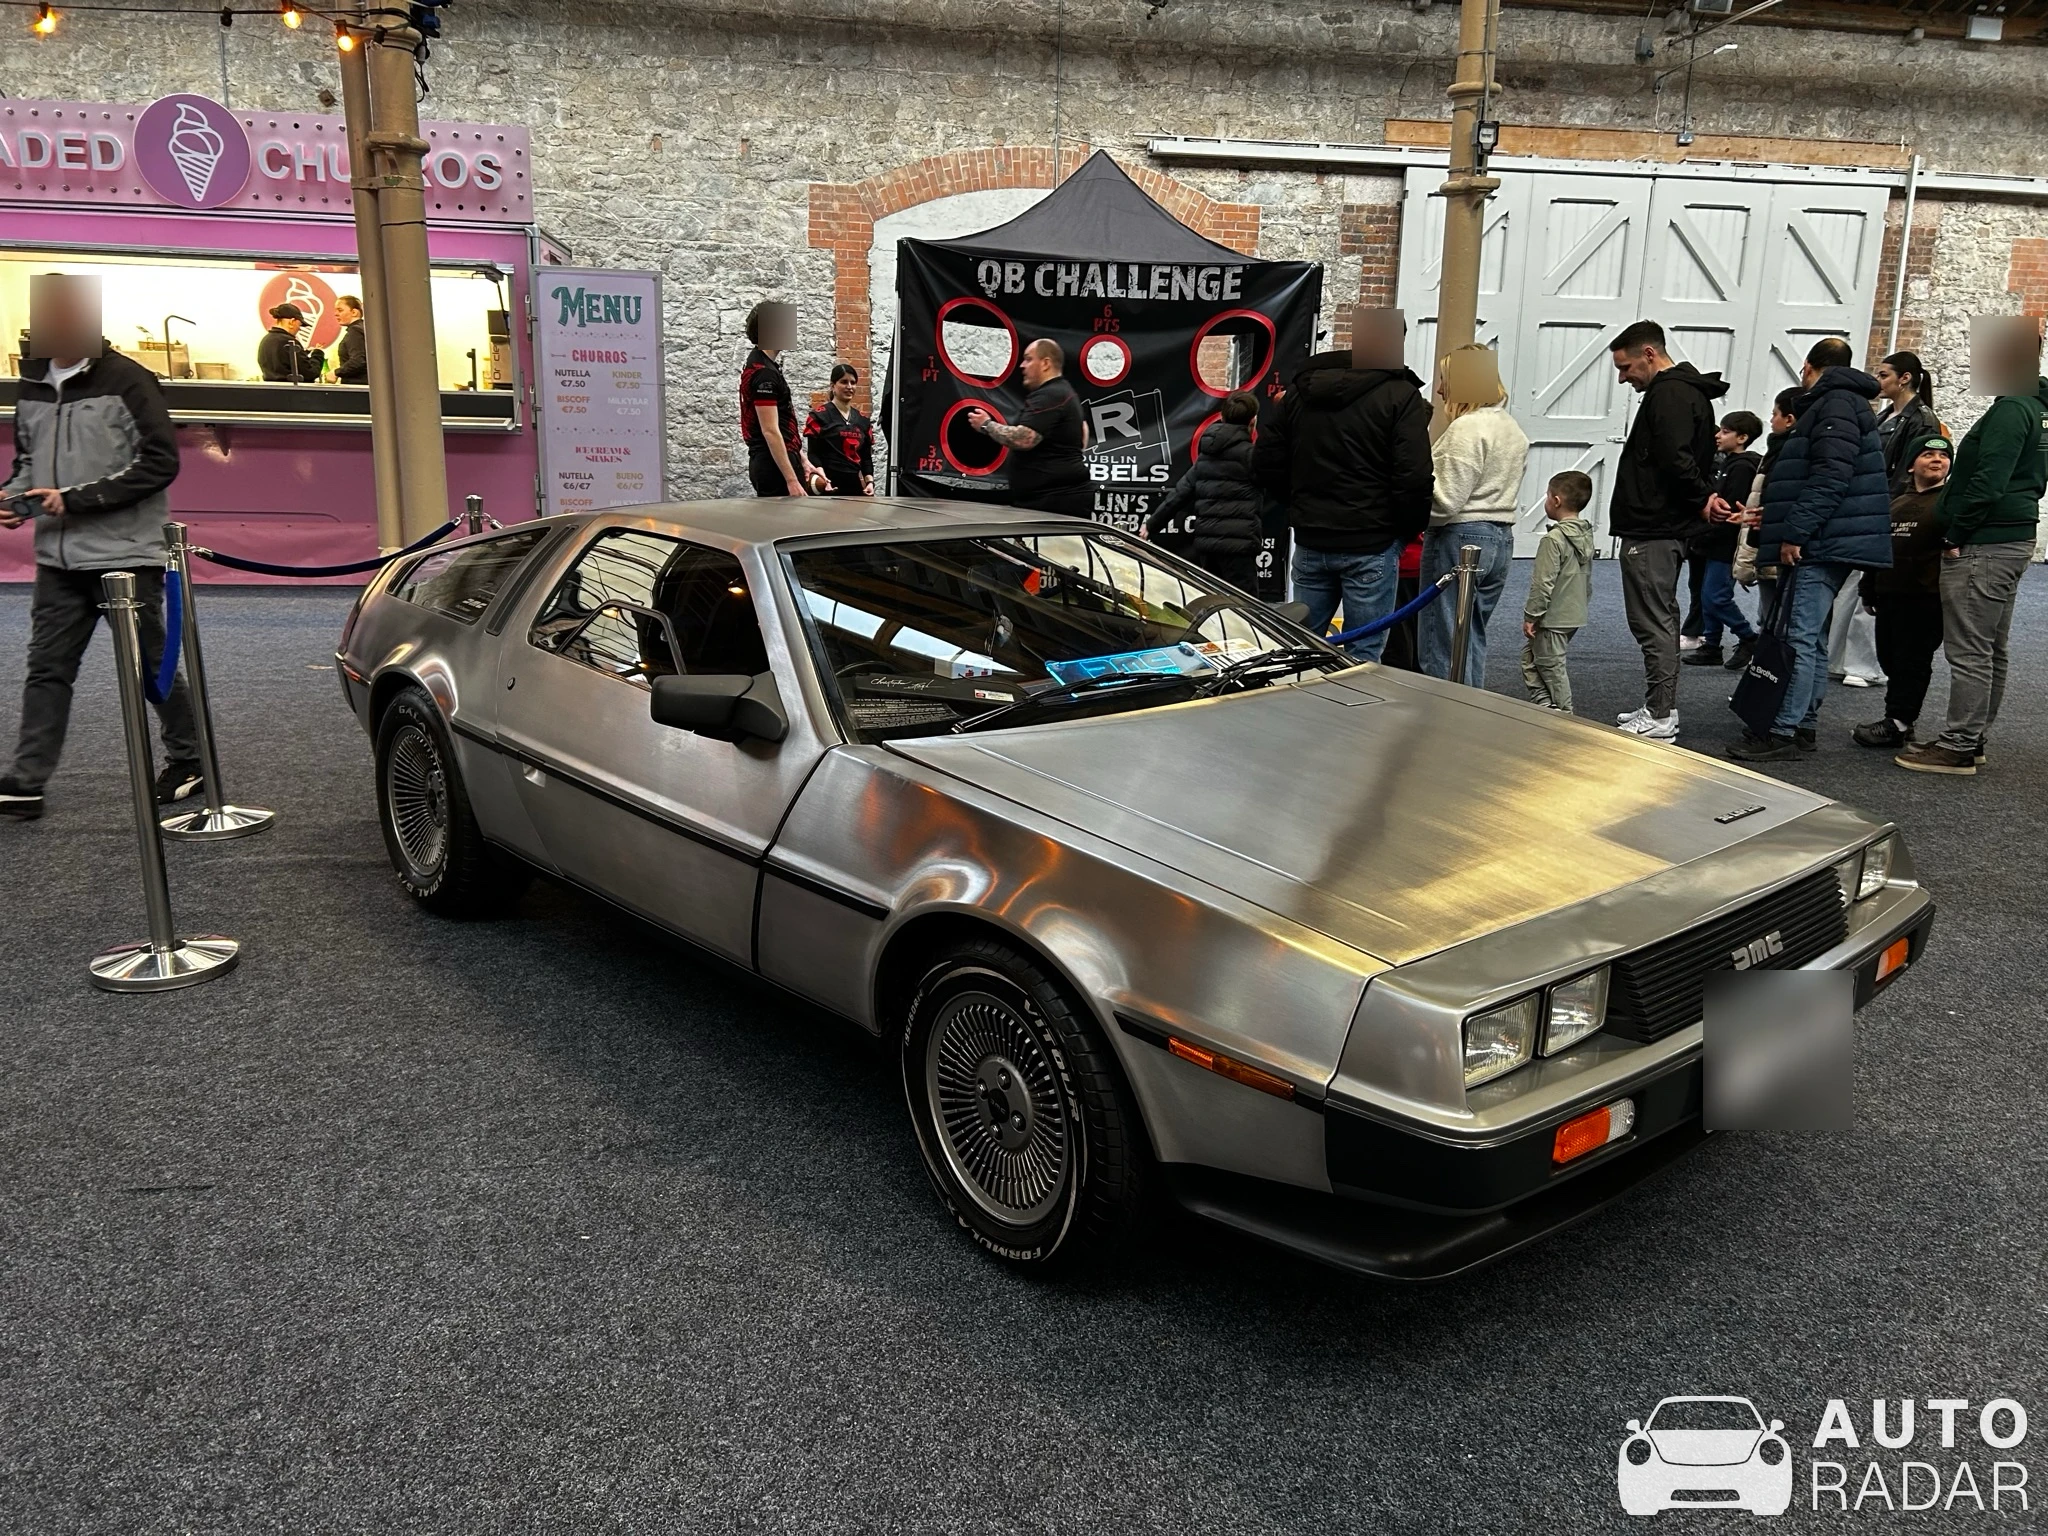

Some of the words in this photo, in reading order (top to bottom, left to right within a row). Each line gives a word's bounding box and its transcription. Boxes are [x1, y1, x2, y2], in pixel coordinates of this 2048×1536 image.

[257, 141, 502, 191] CHUOS
[977, 259, 1025, 298] QB
[1034, 261, 1243, 301] CHALLENGE
[551, 286, 642, 328] MENU
[1103, 304, 1112, 317] 6
[1093, 318, 1120, 332] PTS
[493, 344, 502, 381] Orcle
[572, 349, 628, 364] CHURROS
[928, 355, 934, 368] 1
[555, 369, 591, 378] NUTELLA
[612, 371, 642, 379] KINDER
[922, 369, 939, 382] PT
[560, 379, 586, 388] €7.50
[615, 381, 640, 390] €7.50
[556, 395, 591, 404] BISCOFF
[607, 396, 649, 406] MILKYBAR
[561, 406, 587, 414] €7.50
[616, 407, 641, 416] €7.50
[1091, 401, 1141, 444] R
[590, 446, 621, 455] CREAM
[623, 447, 631, 455] &
[928, 445, 936, 458] 3
[585, 455, 623, 463] SHAKES
[919, 458, 943, 471] PTS
[559, 472, 594, 480] NUTELLA
[616, 472, 644, 480] BUENO
[1086, 463, 1169, 482] BELS
[563, 482, 591, 490] €6/€7
[616, 482, 644, 490] €6/€7
[560, 498, 593, 506] BISCOFF
[1094, 492, 1149, 513] LIN'S
